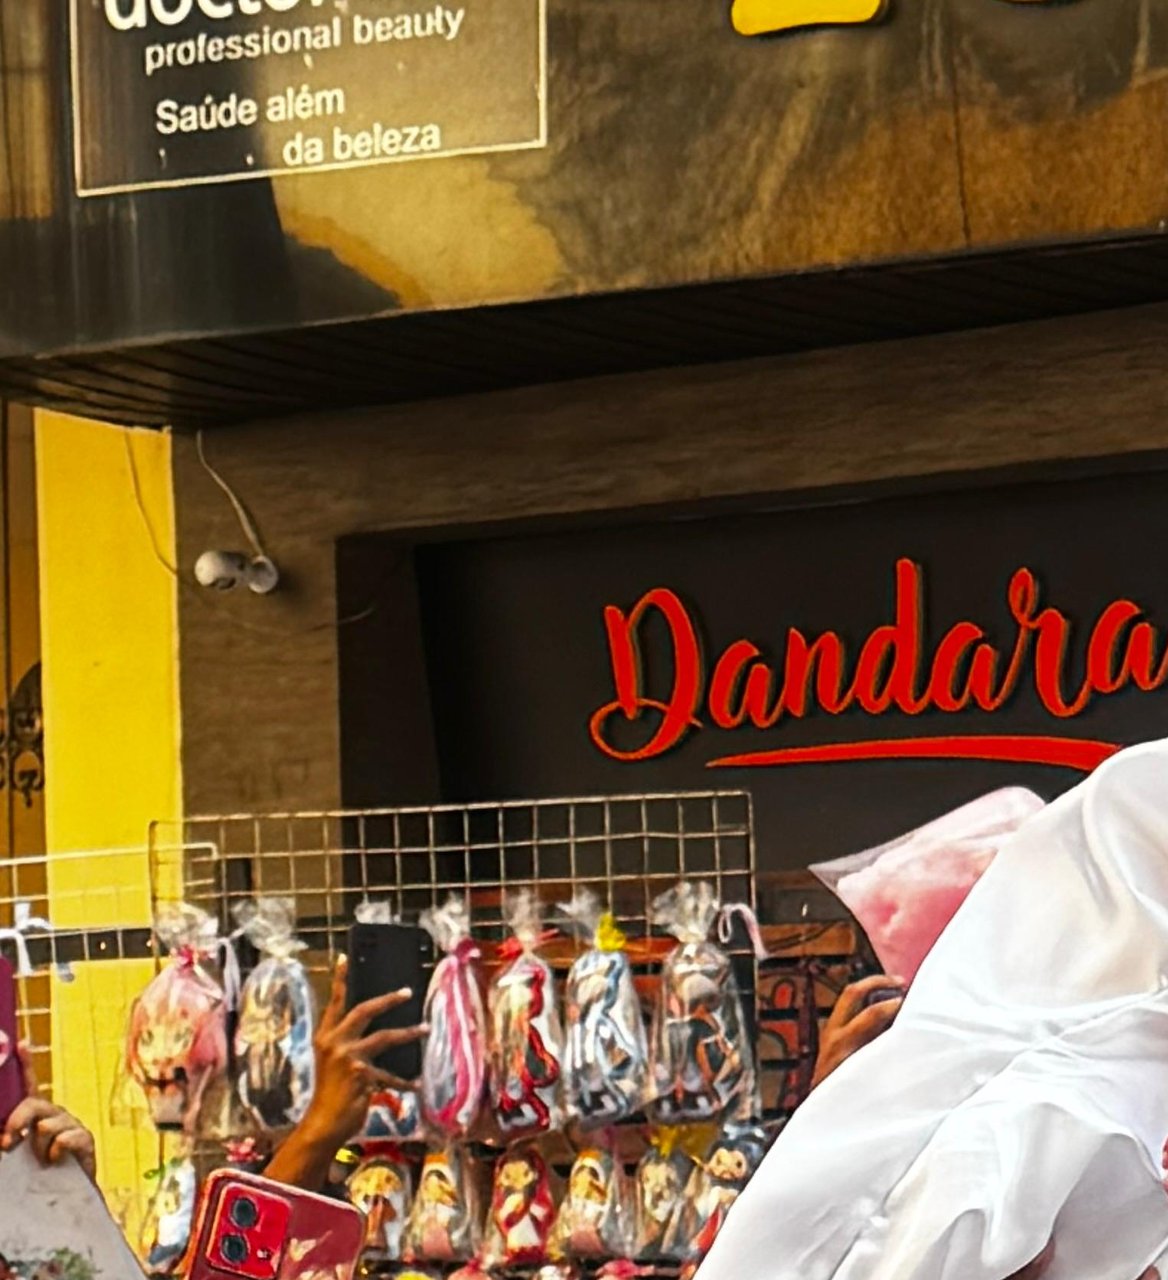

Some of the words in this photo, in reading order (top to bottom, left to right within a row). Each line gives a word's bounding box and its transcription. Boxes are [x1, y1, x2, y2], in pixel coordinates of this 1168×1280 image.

[145, 17, 341, 76] professional
[353, 5, 465, 44] beauty
[156, 94, 258, 135] Saúde
[266, 84, 345, 123] além
[282, 133, 324, 166] da
[332, 122, 441, 160] beleza
